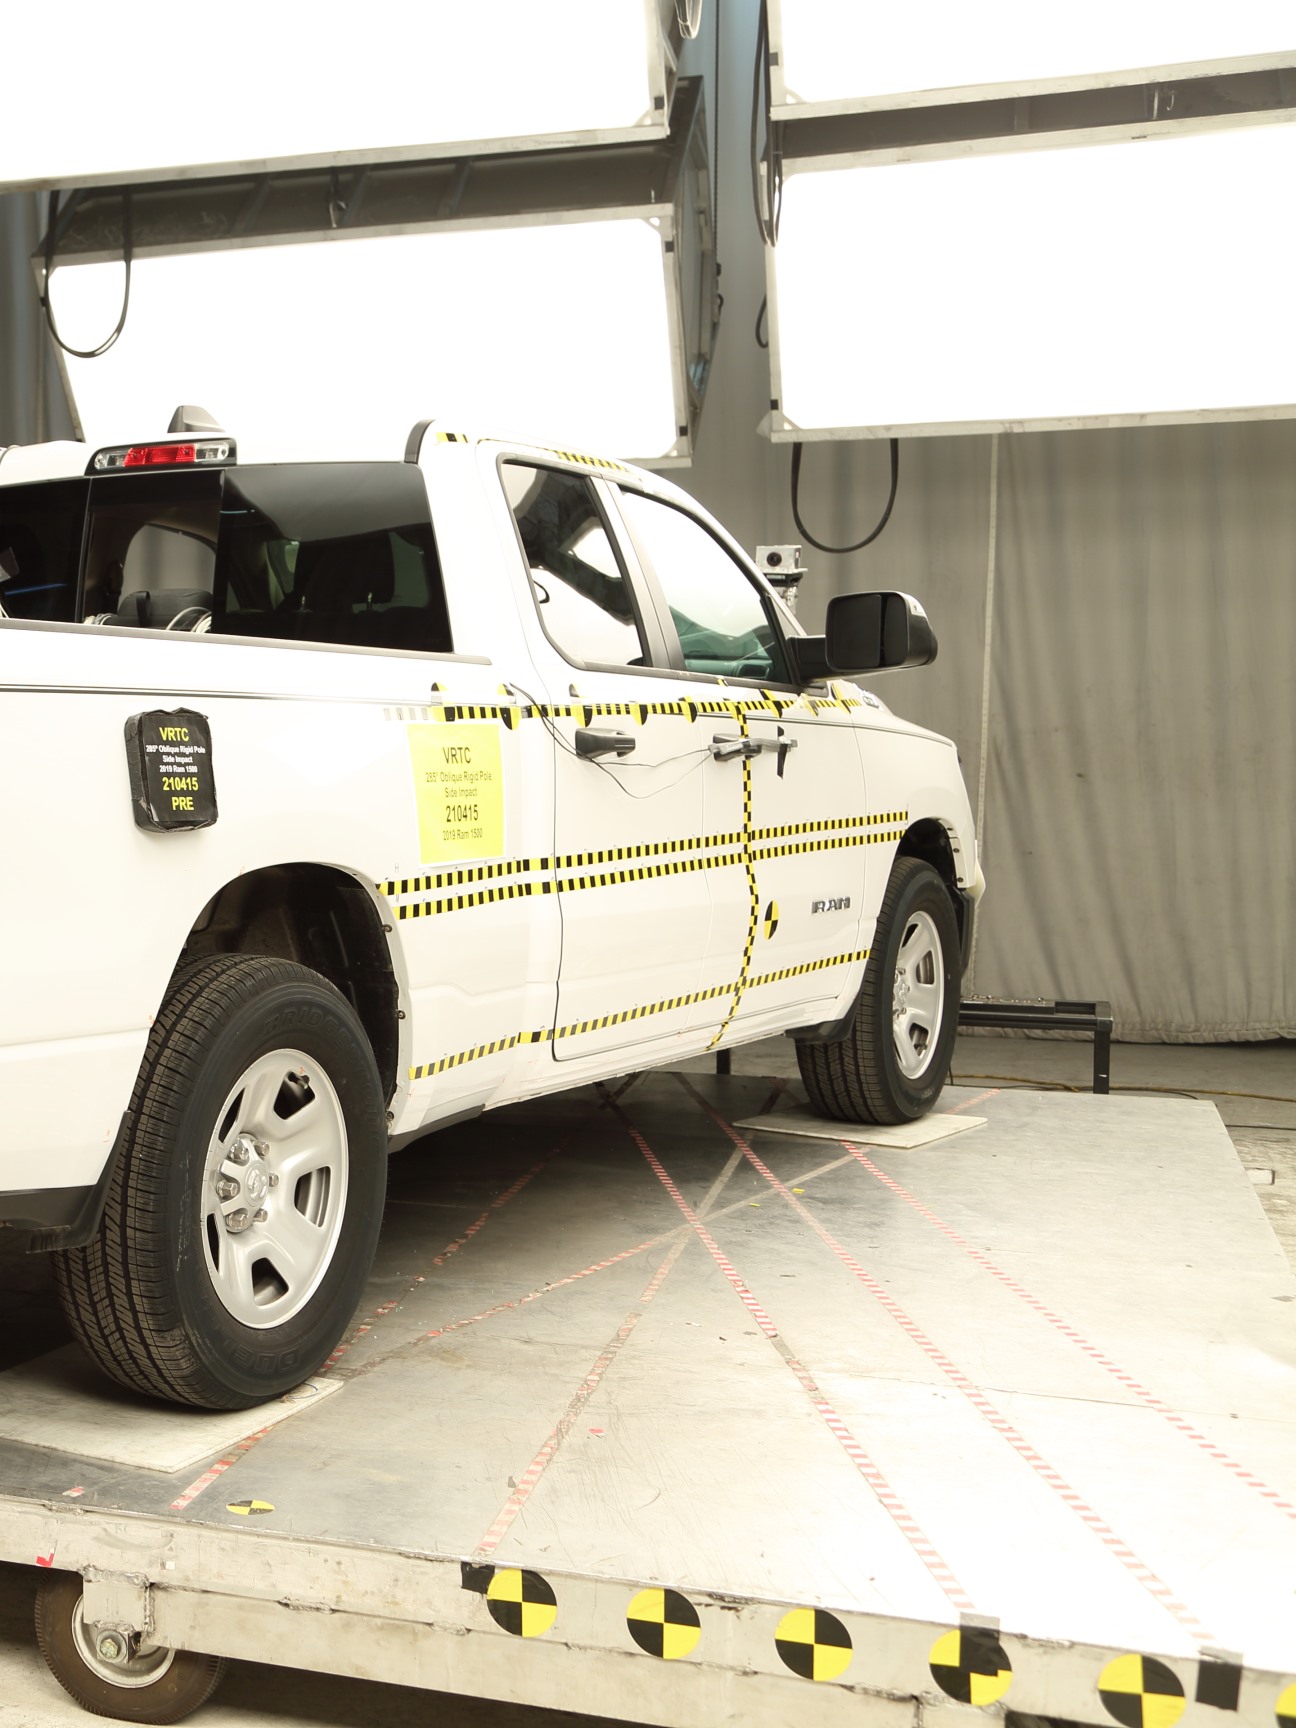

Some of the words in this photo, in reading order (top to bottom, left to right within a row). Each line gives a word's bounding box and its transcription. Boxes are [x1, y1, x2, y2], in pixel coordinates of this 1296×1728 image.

[159, 727, 189, 741] VRTC
[159, 745, 179, 754] Oblique
[180, 746, 193, 755] Rigid
[194, 746, 205, 754] Pole
[443, 747, 471, 764] VRTC
[176, 756, 193, 764] Impact
[159, 765, 172, 773] 2019
[173, 765, 185, 773] Ram
[186, 765, 198, 773] 1500
[162, 777, 198, 790] 210415
[440, 771, 462, 784] Oblique
[464, 771, 479, 784] Rigid
[480, 771, 492, 781] Pole
[445, 788, 457, 797] Side
[459, 788, 477, 798] Impact
[172, 797, 194, 811] PRE
[446, 804, 478, 822] 210415
[443, 830, 456, 841] 2019
[457, 829, 469, 840] Ram
[471, 828, 483, 838] 1500
[812, 896, 850, 914] RAM
